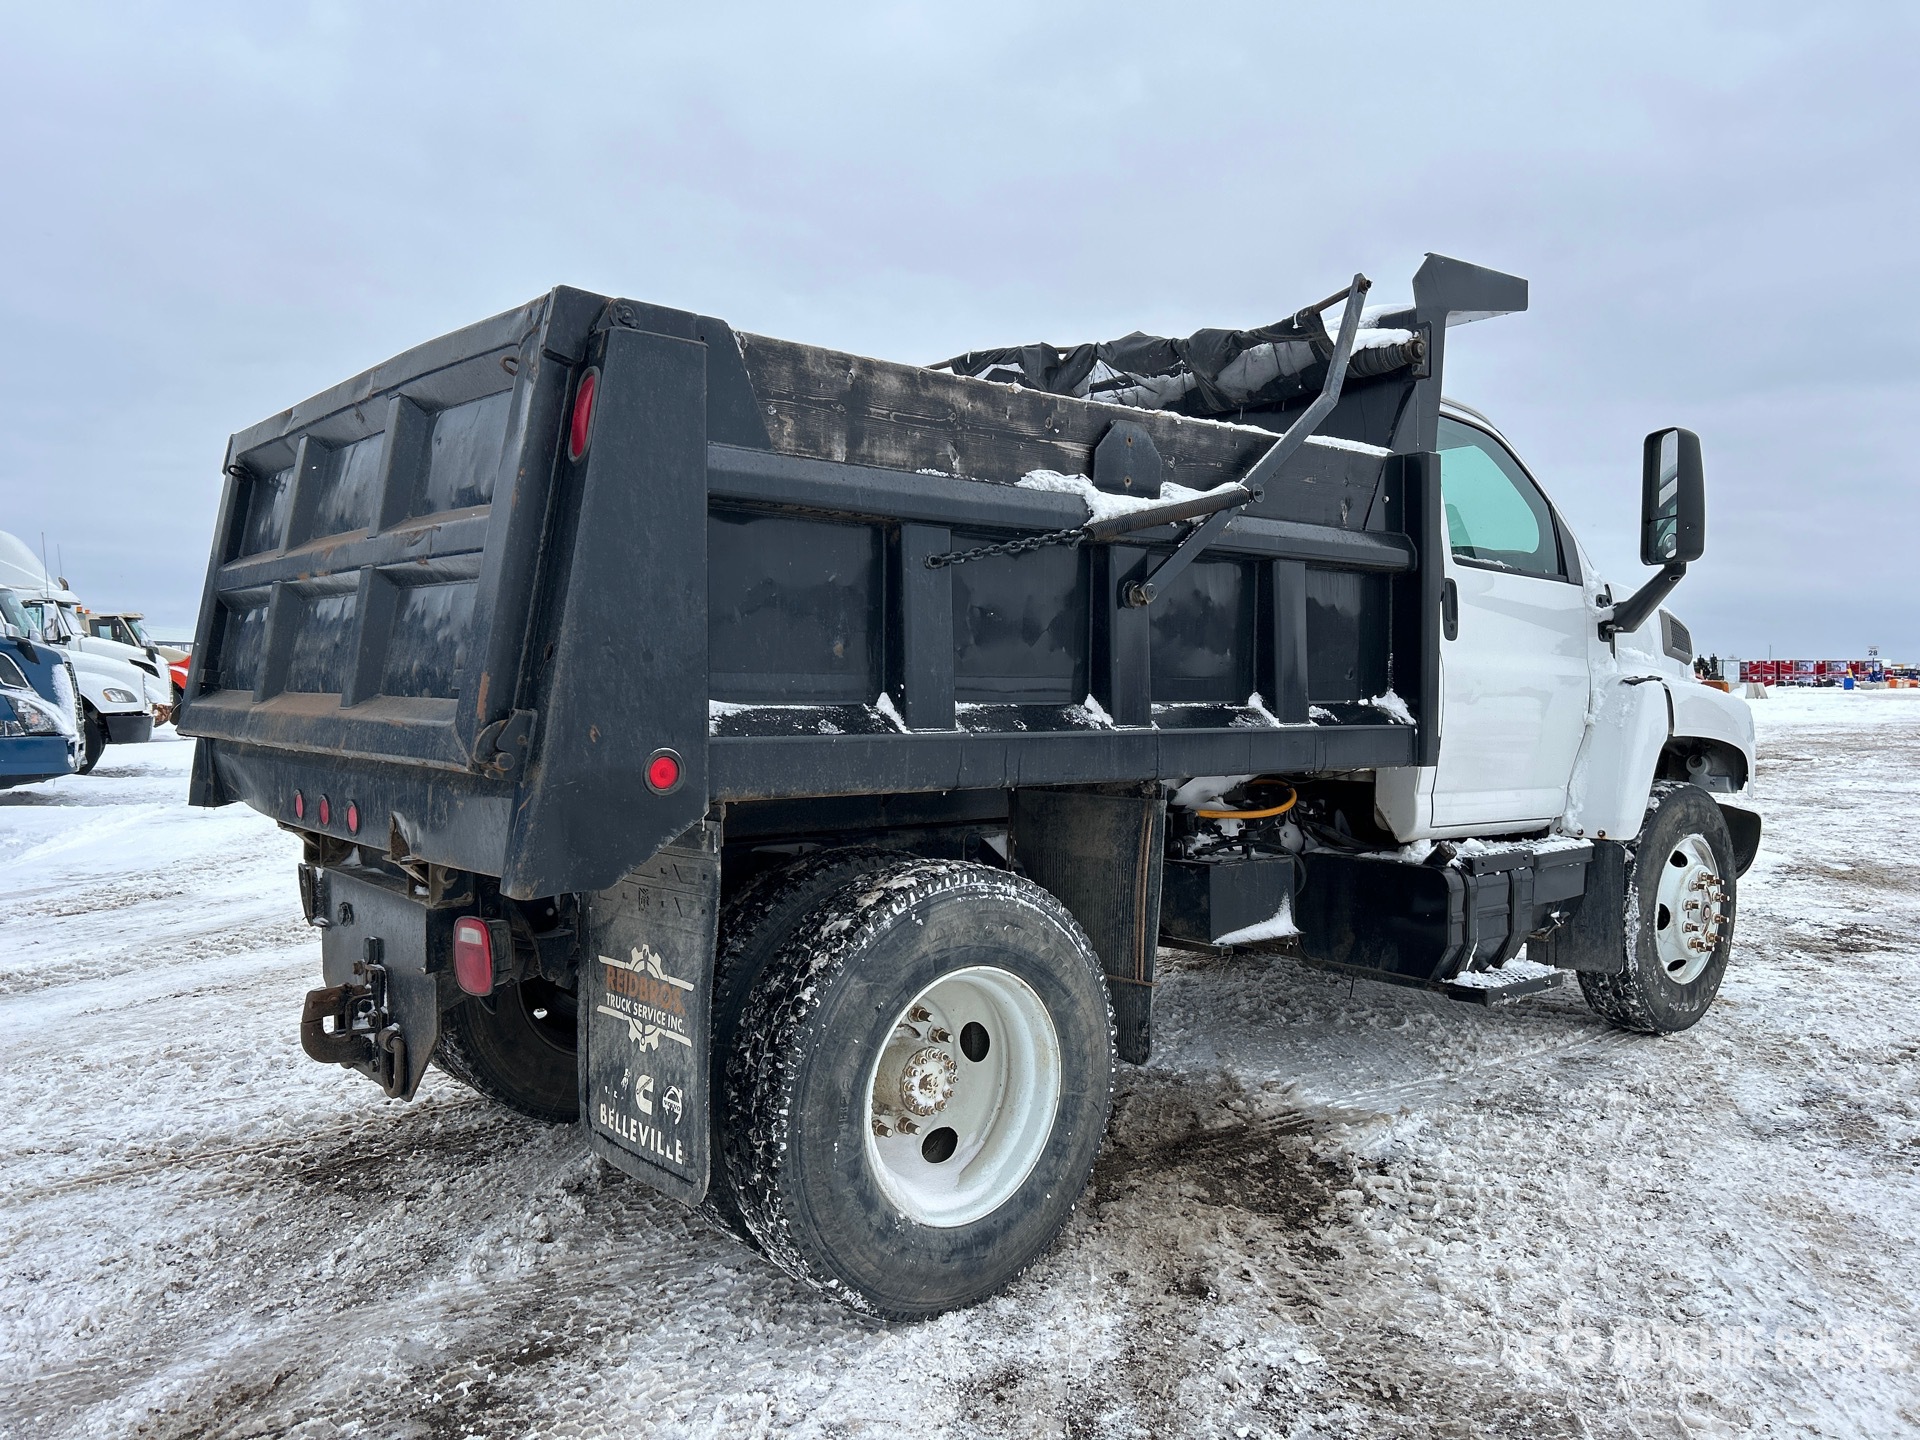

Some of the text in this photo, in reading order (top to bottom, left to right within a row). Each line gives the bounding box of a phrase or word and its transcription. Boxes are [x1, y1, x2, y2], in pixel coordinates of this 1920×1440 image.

[606, 992, 685, 1034] TRUCK SERVICE INC.
[600, 1103, 683, 1165] BELLEVILLE
